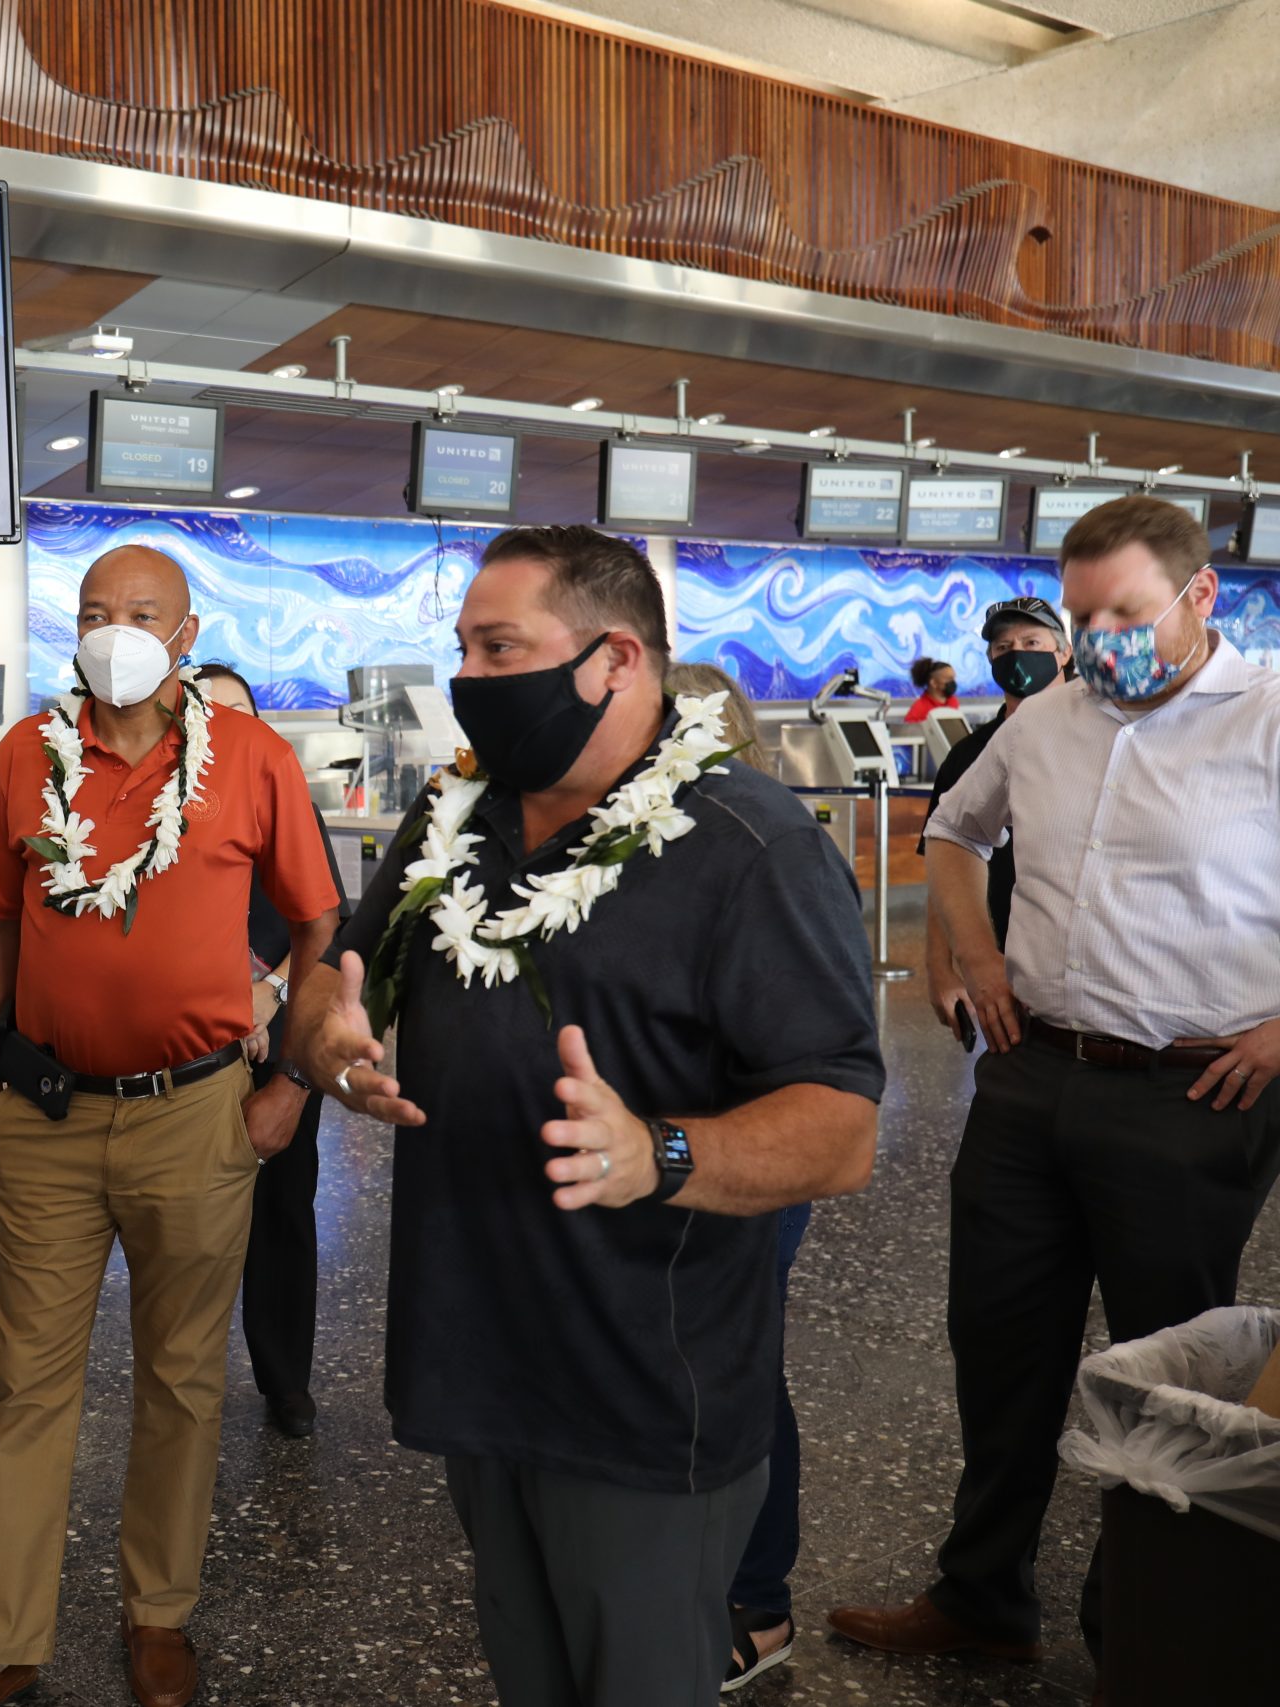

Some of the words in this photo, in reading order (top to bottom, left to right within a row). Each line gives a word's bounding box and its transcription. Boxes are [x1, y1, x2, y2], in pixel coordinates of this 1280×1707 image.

[131, 414, 177, 425] UNITED
[121, 451, 162, 463] CLOSED
[437, 446, 487, 458] UNITED
[187, 457, 208, 473] 19
[438, 475, 471, 486] CLOSED
[819, 480, 876, 488] UNITED
[489, 480, 507, 495] 20
[918, 491, 976, 499] UNITED
[876, 508, 894, 520] 22
[975, 516, 994, 529] 23
